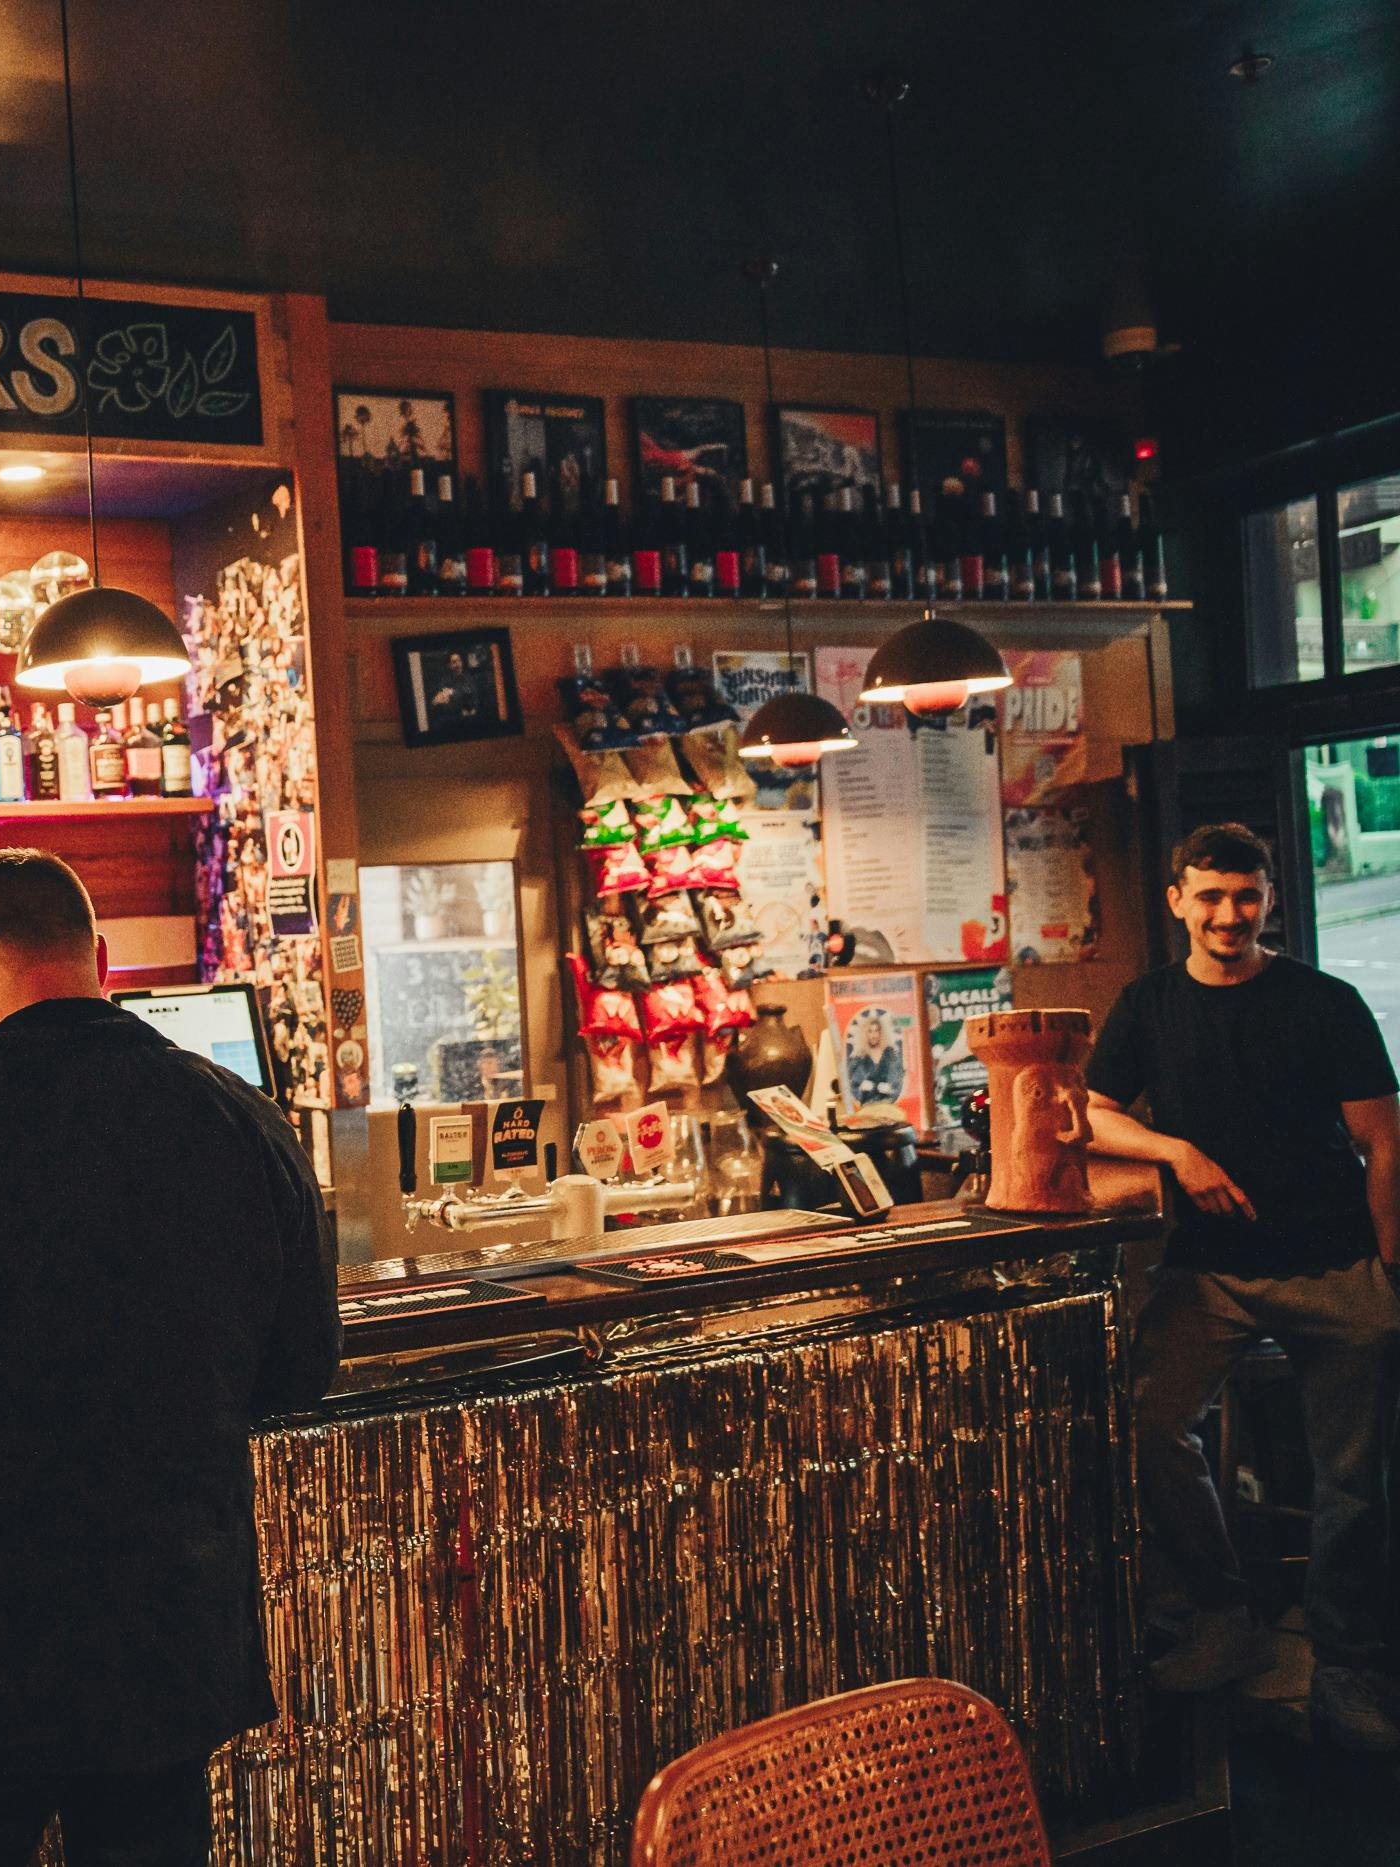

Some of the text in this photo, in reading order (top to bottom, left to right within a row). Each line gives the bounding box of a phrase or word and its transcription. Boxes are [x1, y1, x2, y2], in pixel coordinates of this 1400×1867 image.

[1004, 687, 1079, 733] PRIDE
[503, 1120, 531, 1129] HARD
[493, 1128, 536, 1144] RATED
